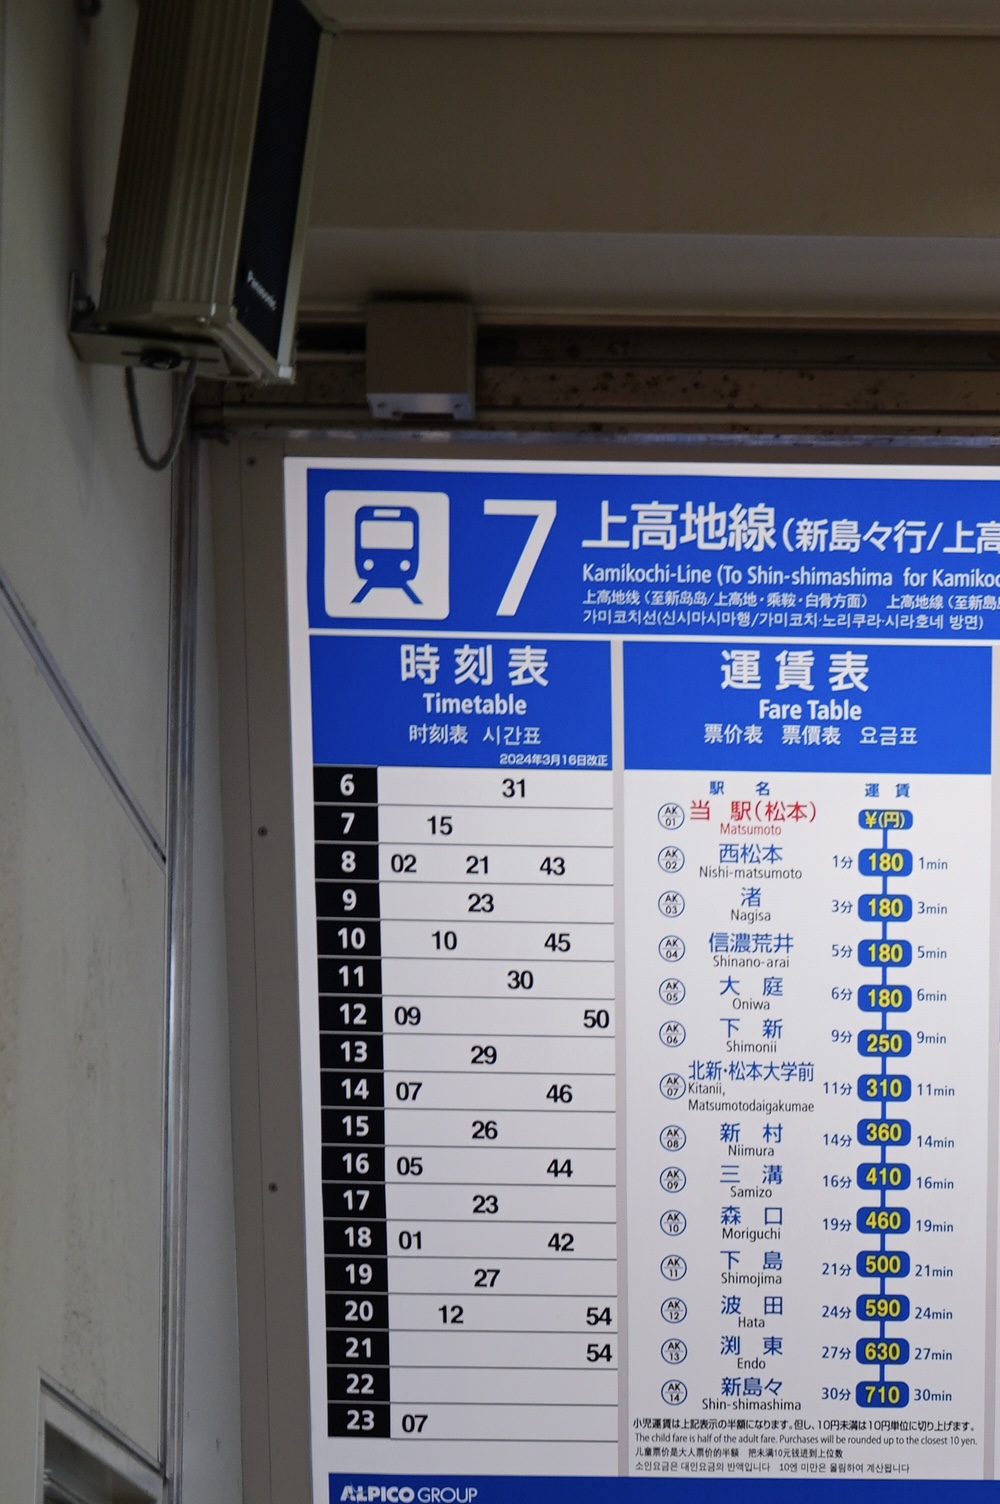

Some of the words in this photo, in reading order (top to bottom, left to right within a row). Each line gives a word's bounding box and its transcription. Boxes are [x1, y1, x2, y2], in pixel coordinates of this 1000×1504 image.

[484, 499, 556, 616] 7
[583, 563, 711, 583] Kamikochi-Line
[717, 565, 742, 586] (To
[748, 565, 892, 586] Shin-shimashima
[903, 567, 927, 586] for
[423, 693, 526, 715] Timetable
[760, 699, 802, 719] Fare
[807, 699, 861, 720] Table
[483, 726, 541, 745] 시간표
[500, 754, 608, 766] 2024年3月16日改正
[341, 774, 354, 795] 6
[503, 779, 525, 797] 31
[341, 813, 354, 833] 7
[428, 816, 452, 835] 15
[720, 823, 781, 835] Matsumoto
[720, 844, 782, 864] 西松本
[869, 853, 903, 871] 180
[700, 866, 802, 879] Nishi-matsumoto
[742, 887, 760, 907] 渚
[731, 909, 770, 924] Nagisa
[338, 928, 365, 949] 10
[432, 931, 457, 950] 10
[545, 933, 570, 952] 45
[709, 933, 793, 953] 信濃荒井
[713, 955, 789, 967] Shinano-arai
[869, 944, 902, 962] 180
[733, 998, 769, 1009] Oniwa
[340, 1003, 366, 1024] 12
[395, 1007, 421, 1025] 09
[584, 1010, 609, 1028] 50
[727, 1040, 776, 1052] Shimonii
[867, 1035, 902, 1052] 250
[689, 1082, 725, 1096] Kitanii,
[866, 1080, 901, 1097] 310
[689, 1099, 814, 1114] Matsumotodaigakumae
[729, 1145, 774, 1156] Niimura
[343, 1153, 369, 1173] 16
[397, 1157, 422, 1175] 05
[547, 1159, 573, 1177] 44
[866, 1212, 901, 1229] 460
[723, 1228, 780, 1242] Moriguchi
[866, 1256, 900, 1273] 500
[722, 1272, 782, 1287] Shimojima
[345, 1301, 374, 1322] 20
[439, 1305, 463, 1323] 12
[587, 1307, 612, 1325] 54
[866, 1299, 900, 1317] 590
[739, 1317, 764, 1327] Hata
[865, 1343, 899, 1360] 630
[722, 1377, 782, 1396] 新島々
[866, 1386, 899, 1403] 710
[702, 1398, 801, 1410] Shin-shimashima
[347, 1410, 374, 1430] 23
[402, 1415, 428, 1432] 07
[341, 1486, 415, 1503] ALPICO
[418, 1487, 477, 1503] GROUP
